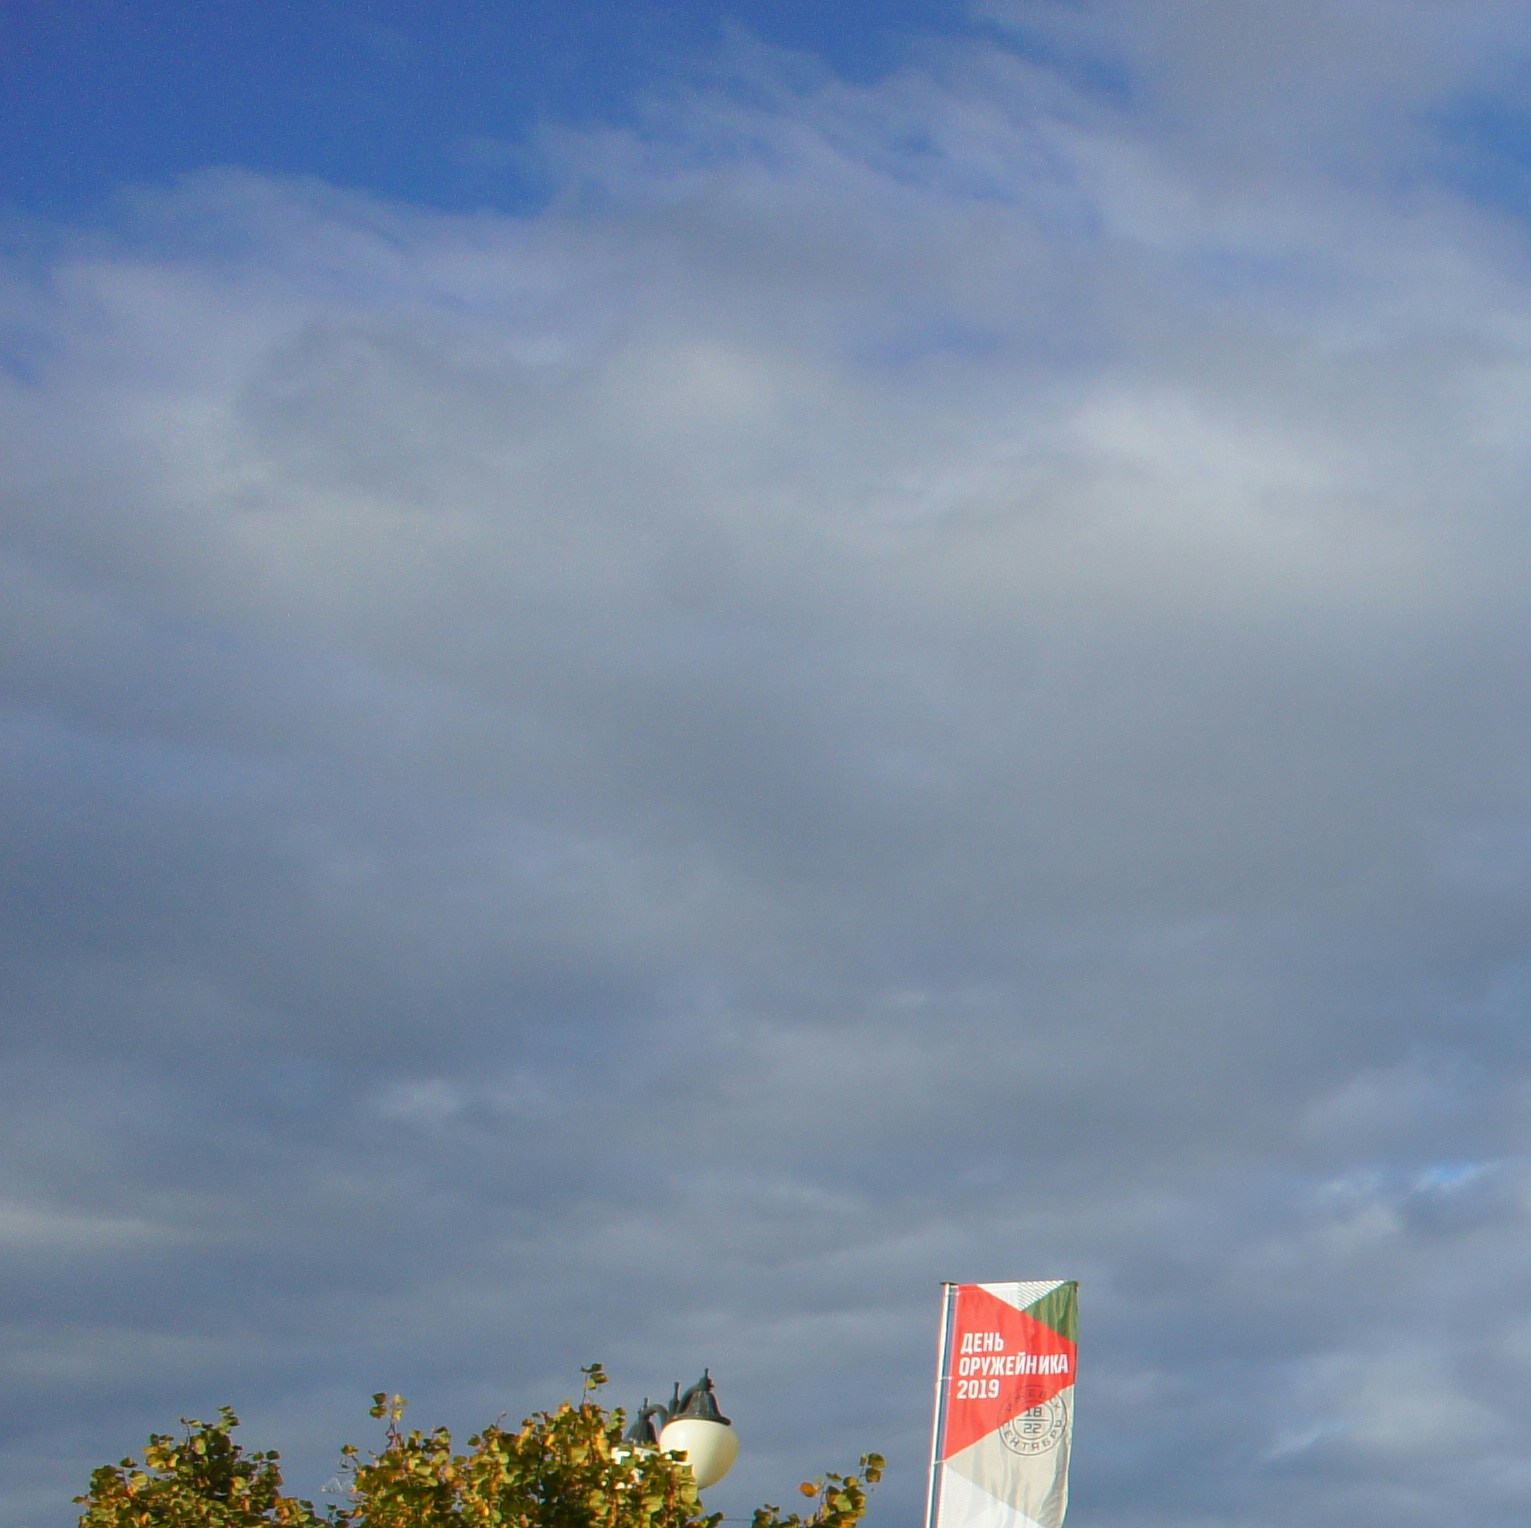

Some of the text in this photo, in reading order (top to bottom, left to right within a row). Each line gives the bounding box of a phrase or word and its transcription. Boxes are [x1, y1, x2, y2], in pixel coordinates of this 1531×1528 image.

[960, 1332, 1004, 1355] ДЕНЬ
[958, 1352, 1069, 1376] ОРУЖЕЙНИКА
[957, 1379, 1000, 1399] 2019
[1025, 1407, 1042, 1417] 18
[1023, 1423, 1042, 1434] 22
